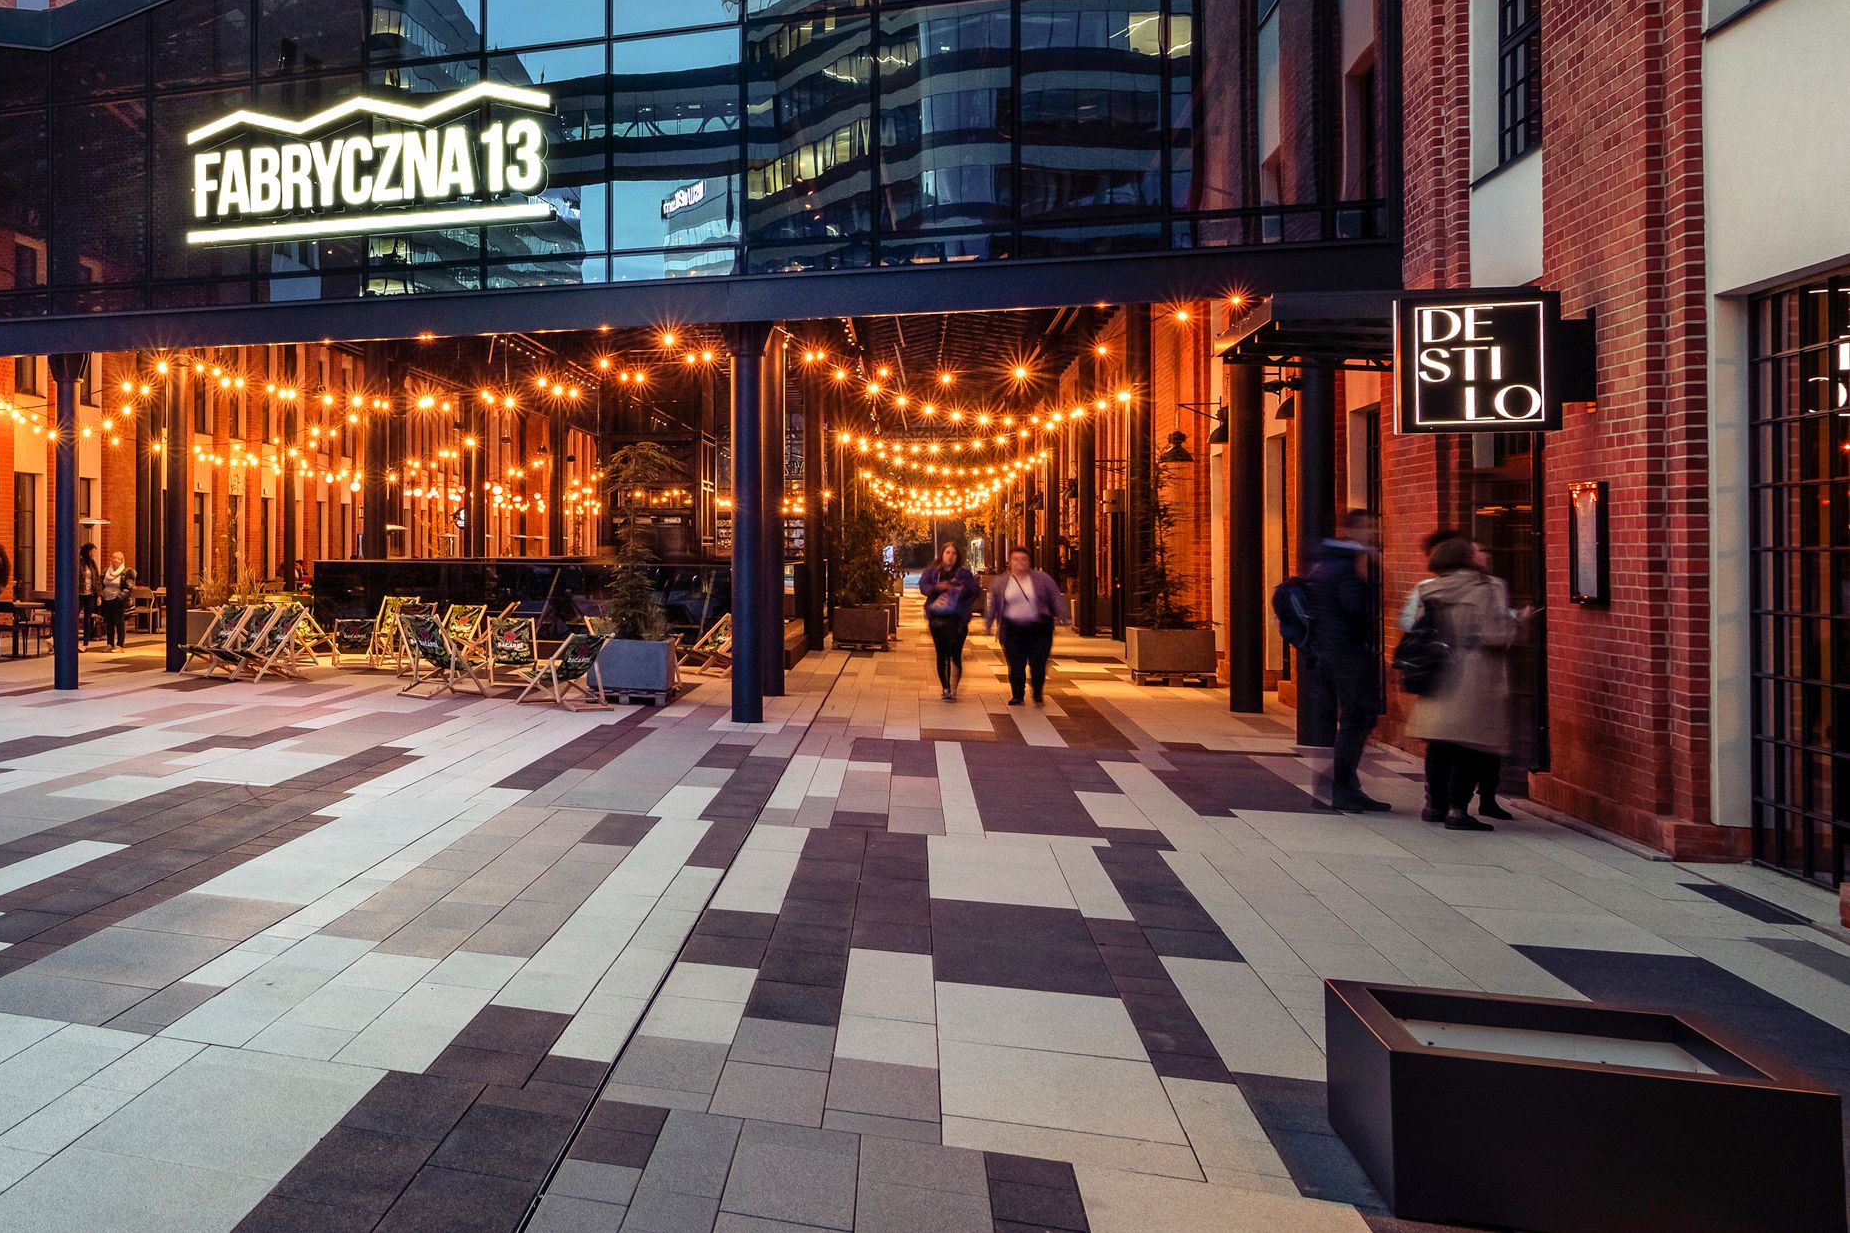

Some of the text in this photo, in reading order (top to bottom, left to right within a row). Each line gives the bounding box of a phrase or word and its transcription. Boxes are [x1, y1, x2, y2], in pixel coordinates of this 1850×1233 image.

[193, 117, 544, 218] FABRYCZNA 13
[1422, 306, 1495, 343] DE
[1418, 346, 1502, 383] STI
[1464, 384, 1542, 421] LO
